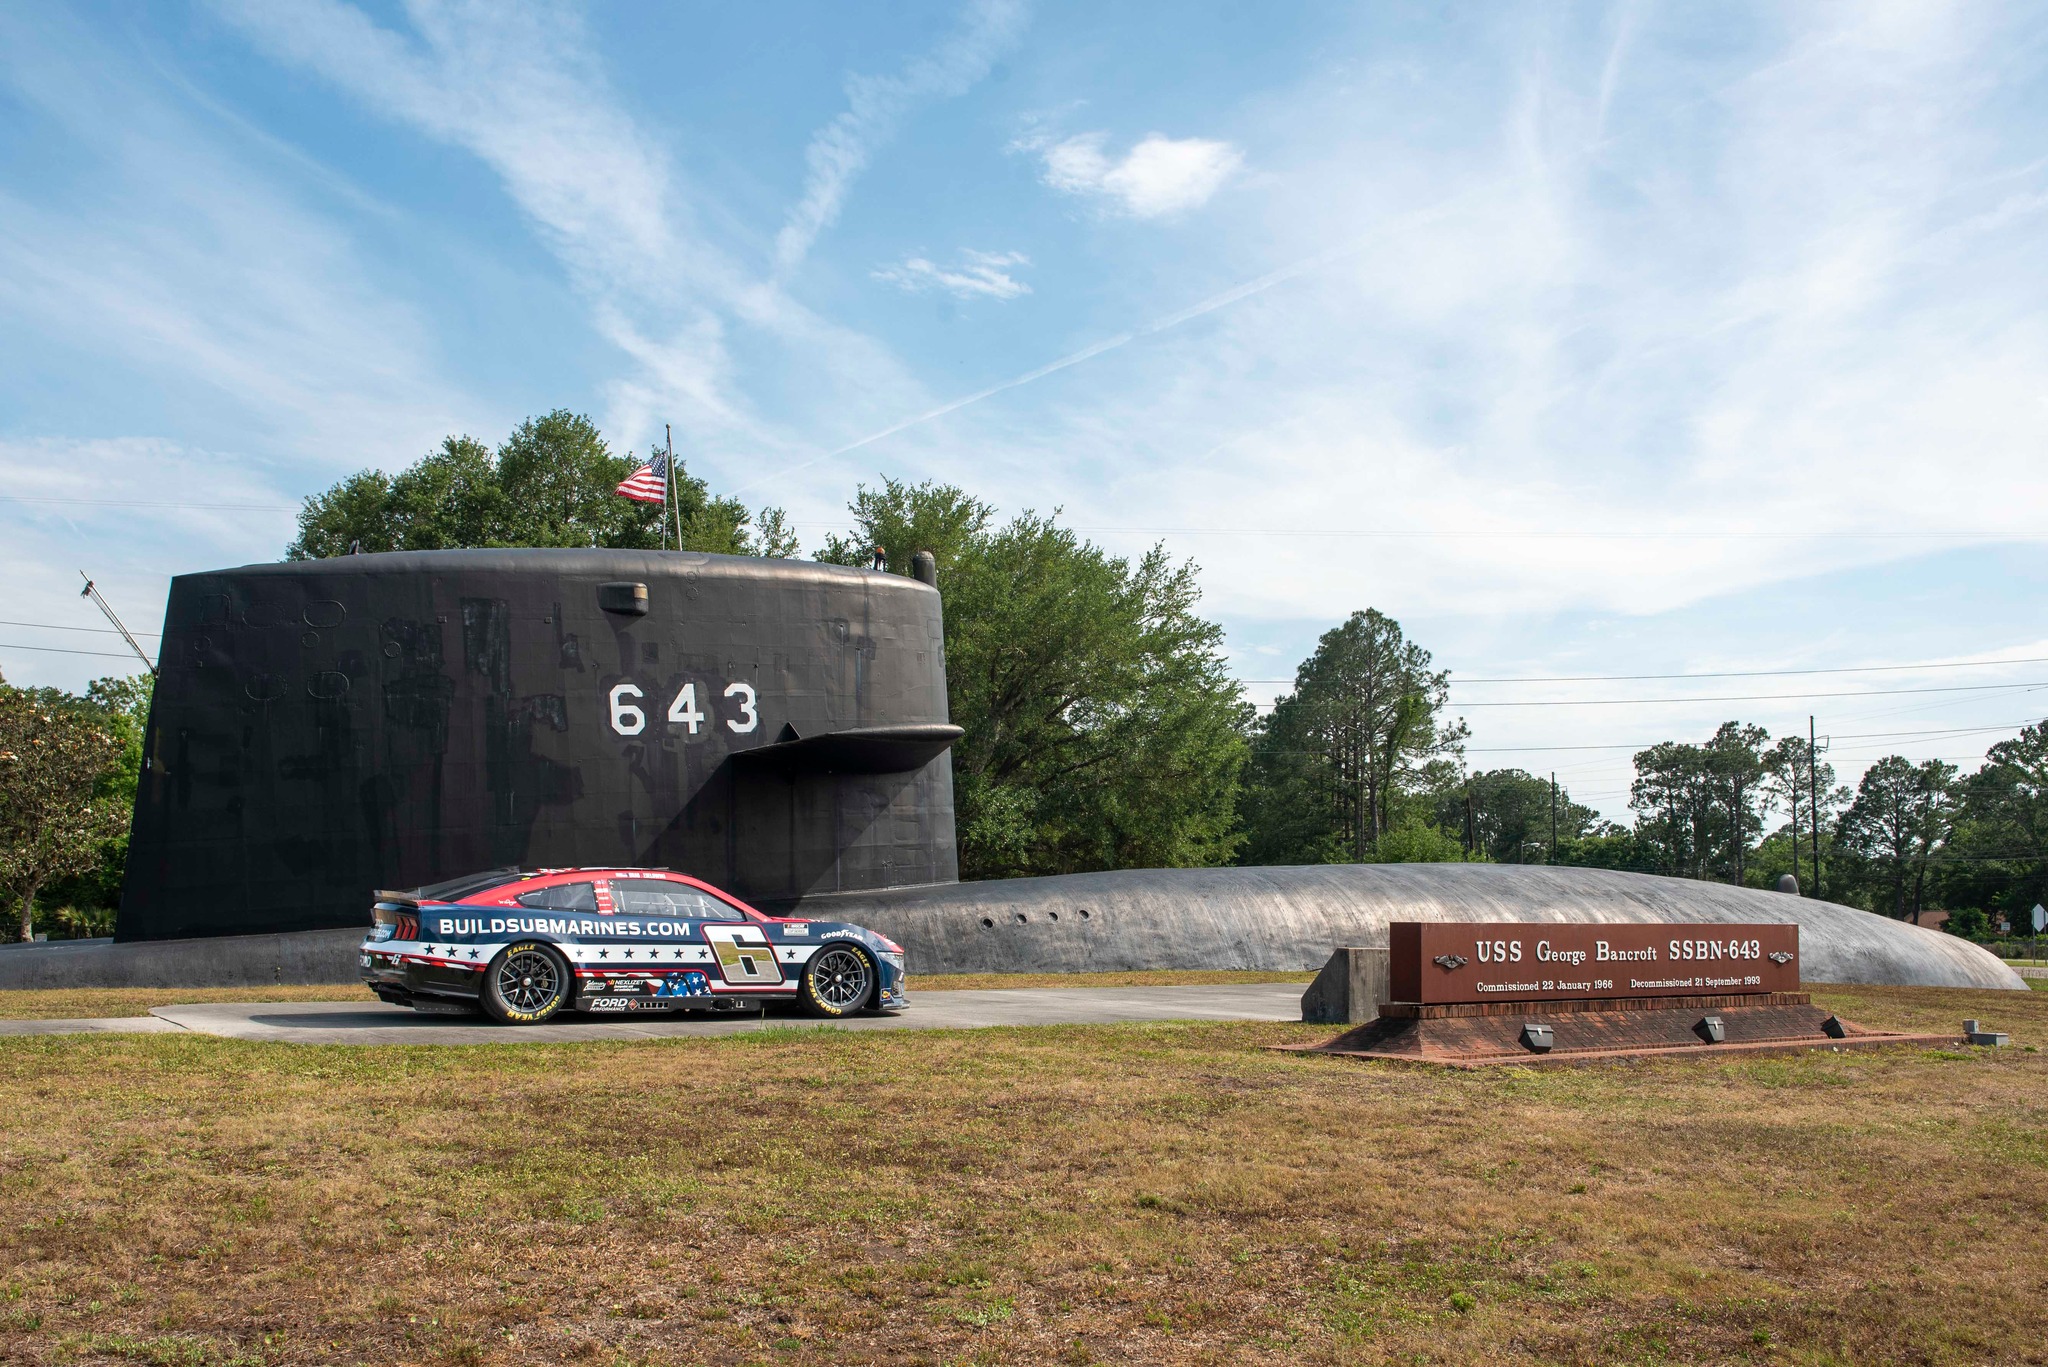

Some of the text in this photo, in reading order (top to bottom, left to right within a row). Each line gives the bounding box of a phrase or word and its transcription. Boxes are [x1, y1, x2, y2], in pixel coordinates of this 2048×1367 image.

[609, 683, 757, 735] 643
[439, 918, 691, 936] BUILDSUBMARINES.COM
[820, 929, 864, 940] GOODYEAR
[507, 944, 536, 958] EAGLE
[703, 925, 783, 983] 6
[851, 946, 871, 968] EAGLE
[1476, 940, 1760, 965] USS George Bancroft SSBN-643
[1476, 979, 1613, 992] Commissioned 22 January 1966
[1630, 975, 1761, 988] Decommissioned 21 September 1993
[591, 998, 628, 1007] FORD
